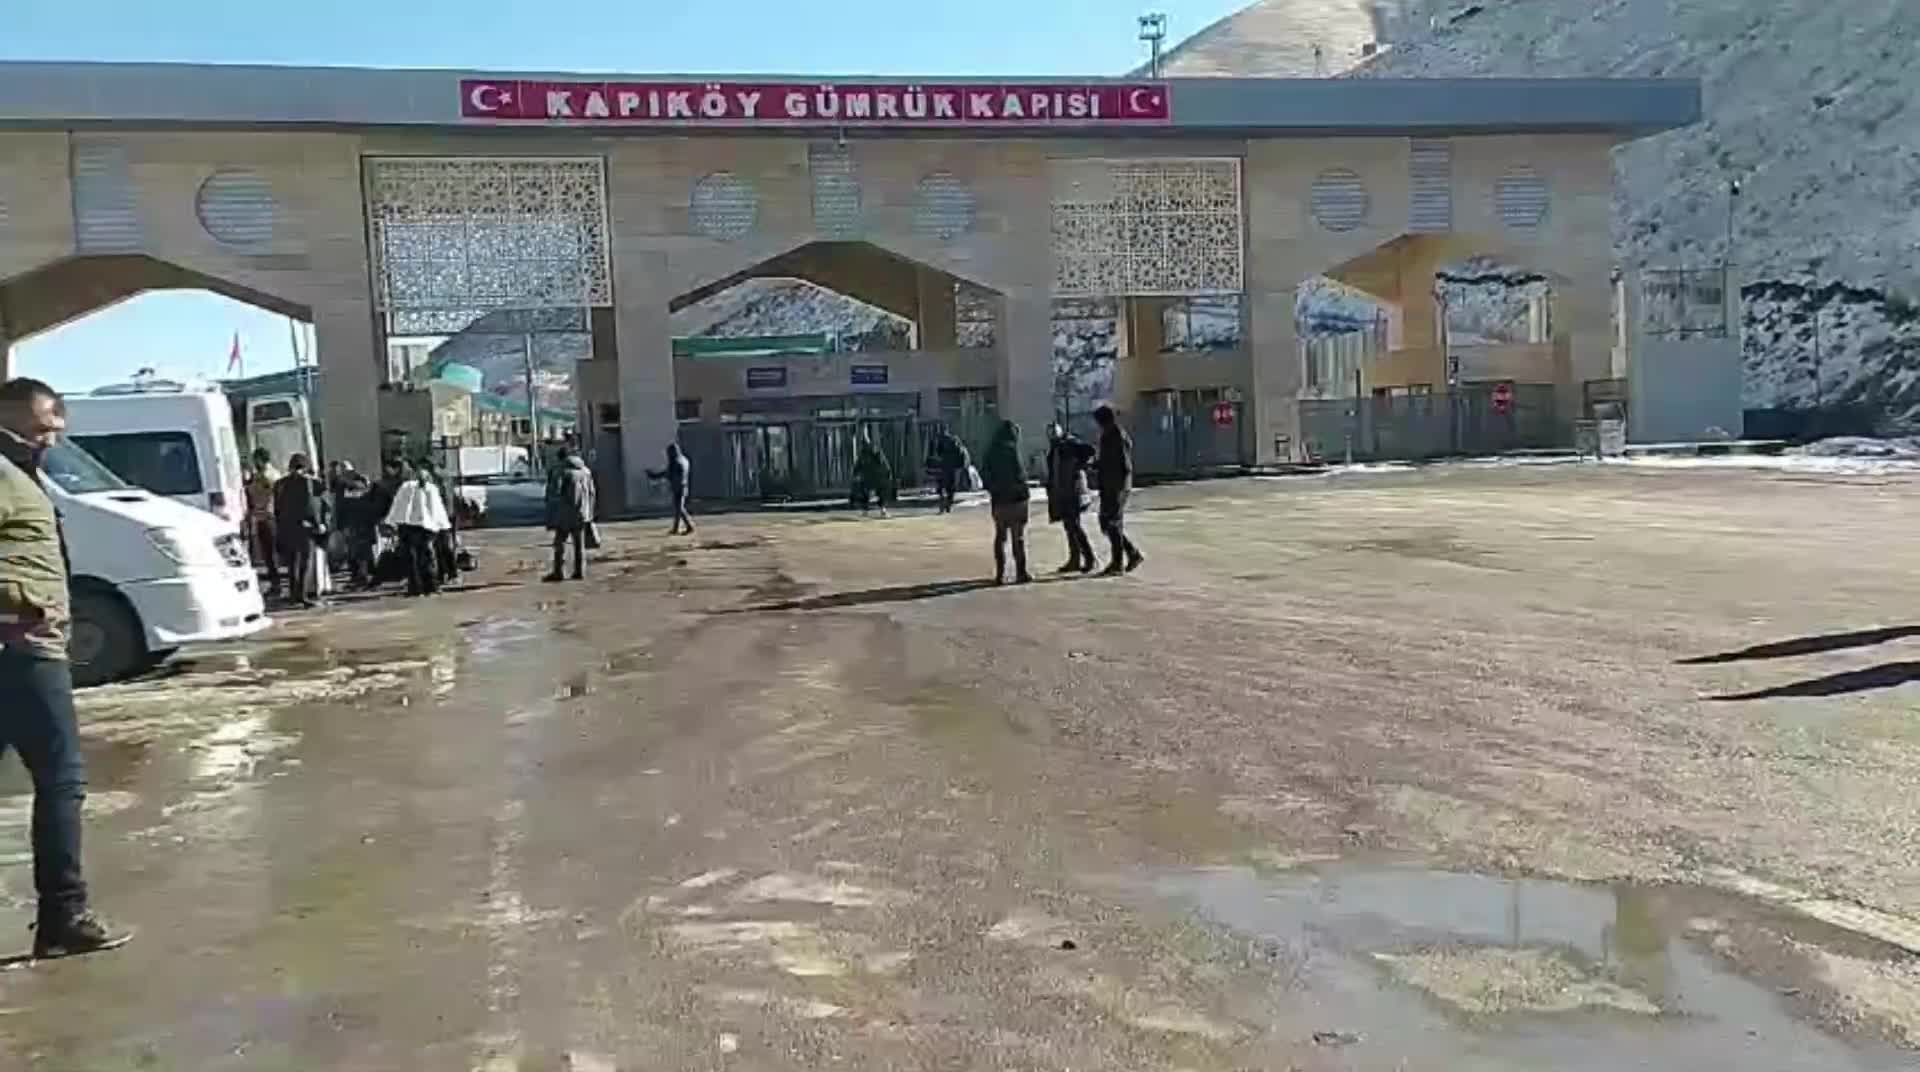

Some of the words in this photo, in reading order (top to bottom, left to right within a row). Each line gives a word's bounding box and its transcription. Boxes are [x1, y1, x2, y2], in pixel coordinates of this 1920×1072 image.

[546, 83, 761, 117] KAPIKÖY
[785, 84, 956, 118] GÜMRÜK
[969, 92, 1099, 117] KAPISI
